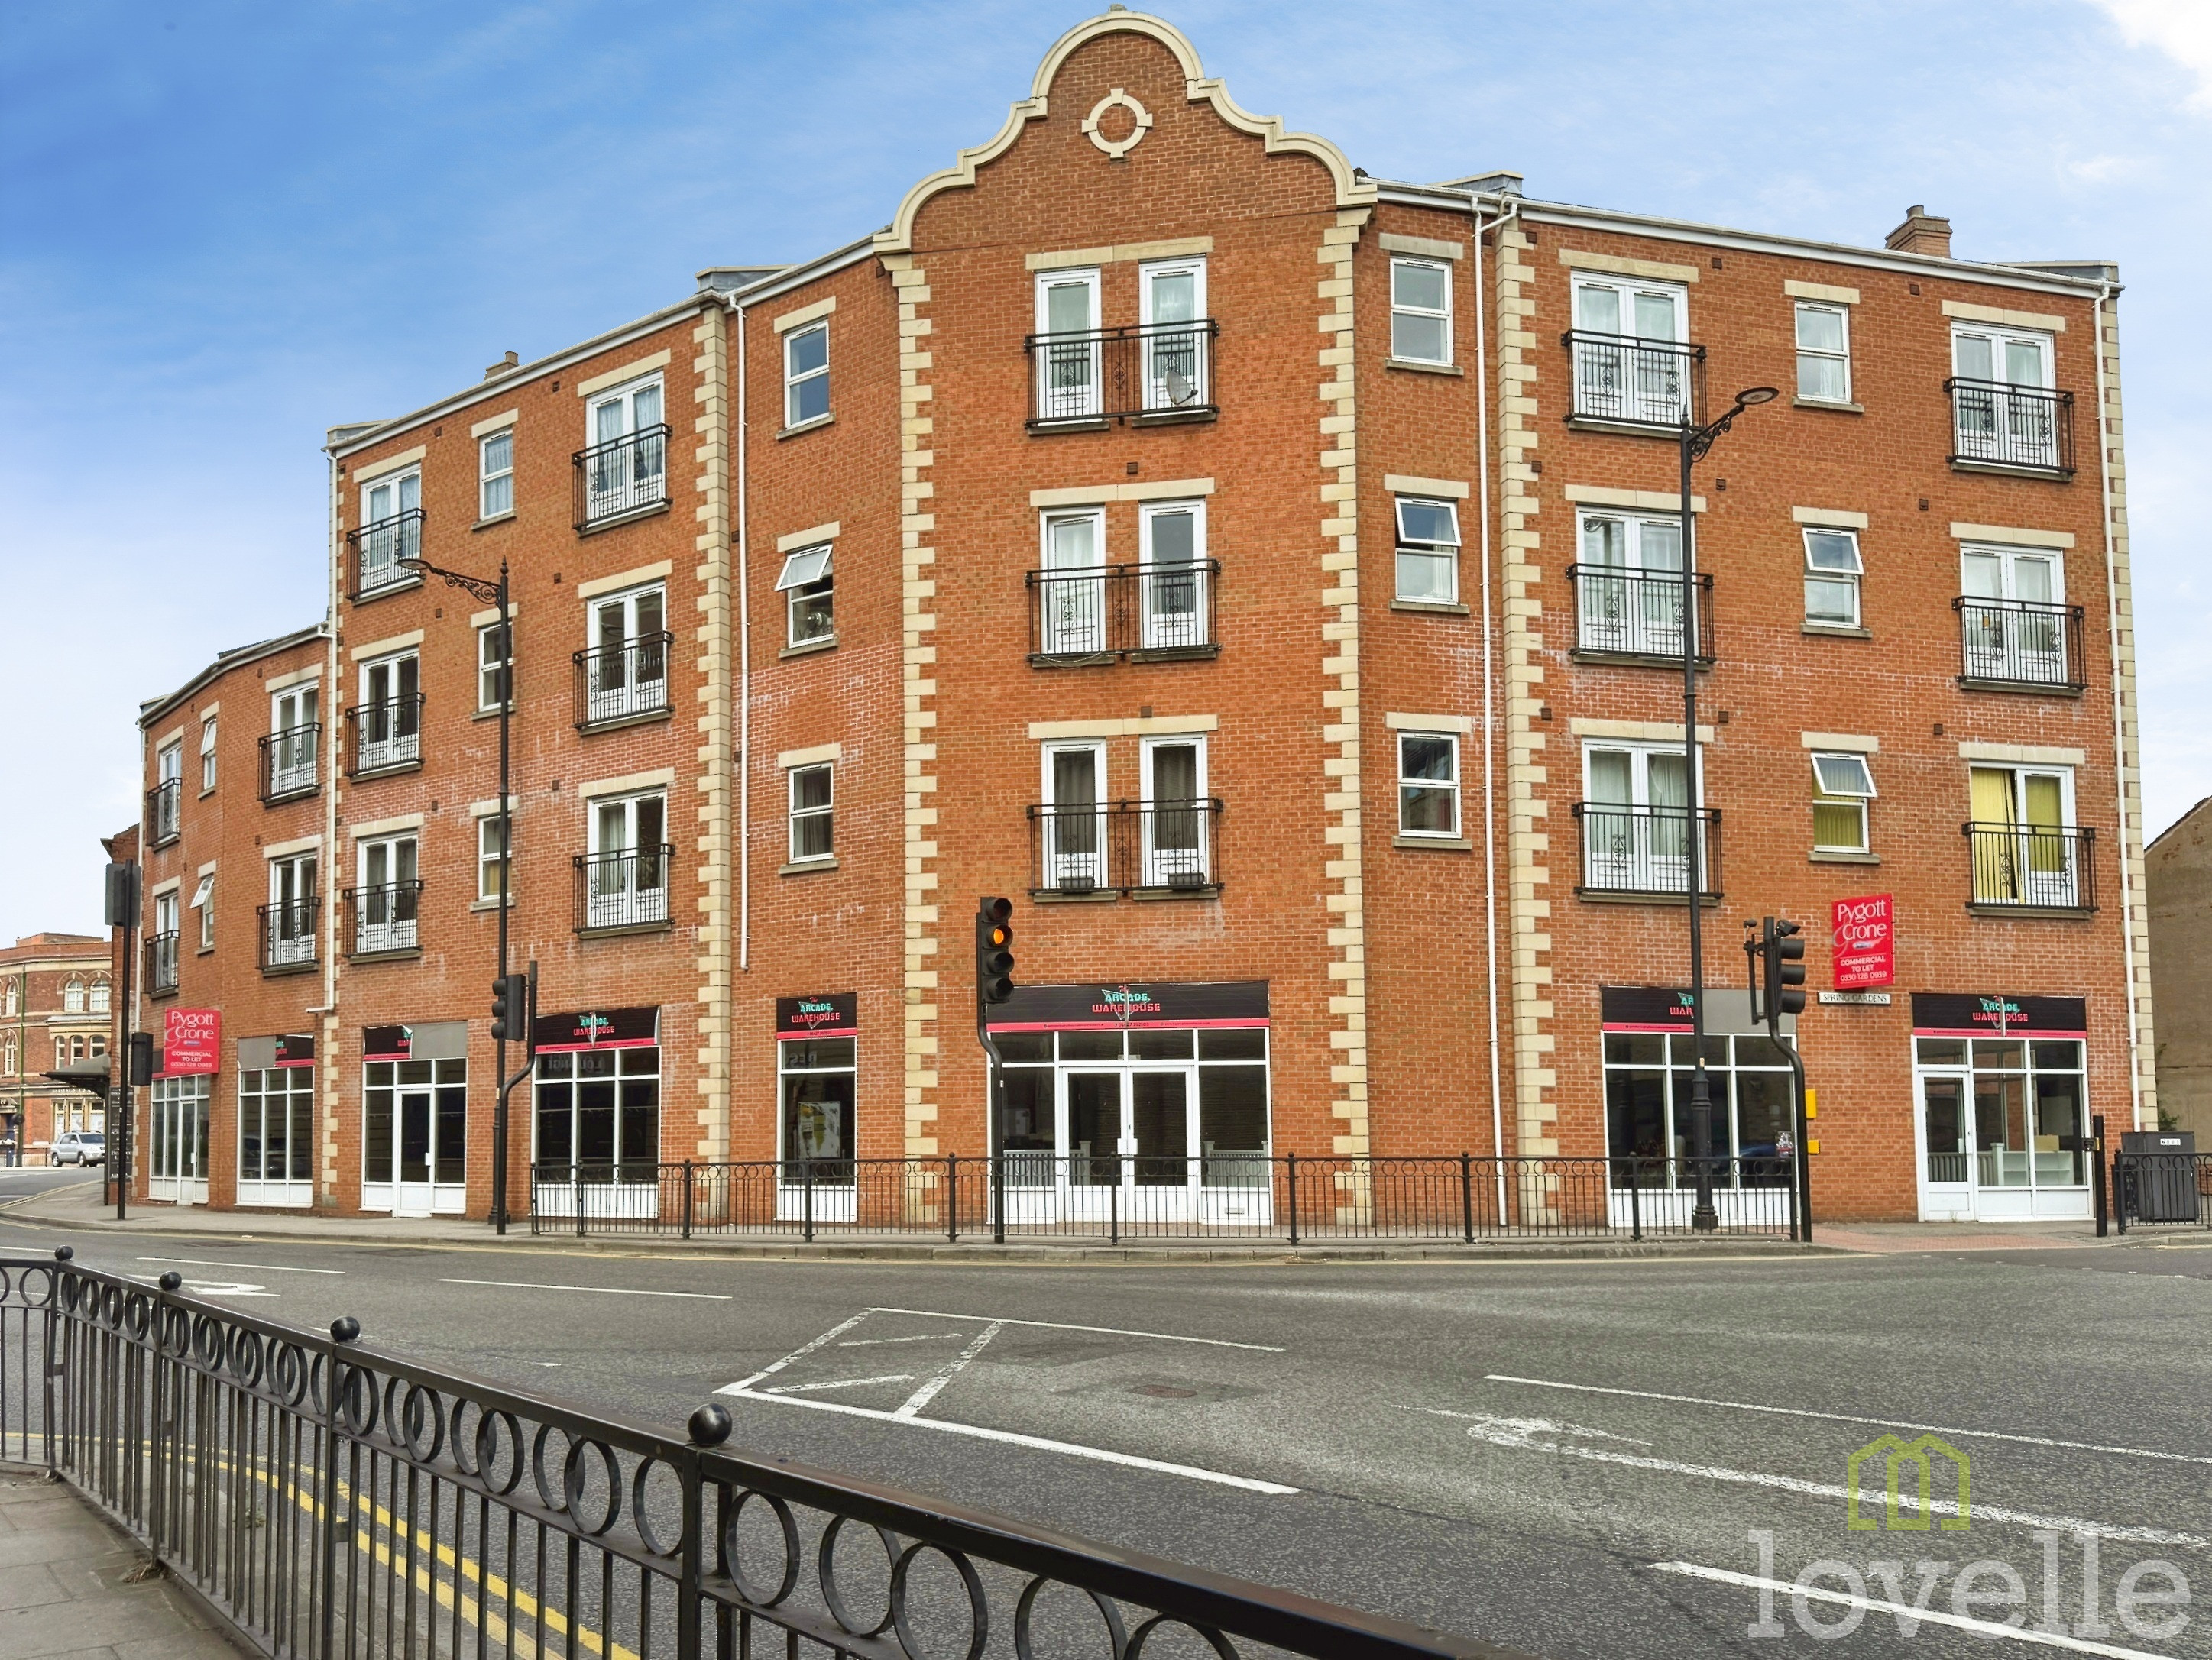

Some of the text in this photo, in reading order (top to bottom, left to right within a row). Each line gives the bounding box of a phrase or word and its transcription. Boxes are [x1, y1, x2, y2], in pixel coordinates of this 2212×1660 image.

[1837, 899, 1887, 923] Pygott
[1842, 923, 1887, 940] Crone
[1840, 956, 1886, 966] COMMERCIAL
[1862, 964, 1874, 972] LET
[1851, 994, 1887, 1002] GARDENS
[800, 1003, 832, 1013] ARCADE
[1983, 1003, 2017, 1011] ARCDE
[171, 1011, 214, 1027] Pygott
[792, 1012, 840, 1023] WAREHOUSE
[1972, 1012, 2029, 1022] WAREOUSE
[175, 1026, 214, 1040] Crone
[574, 1026, 614, 1036] WAREOUSE
